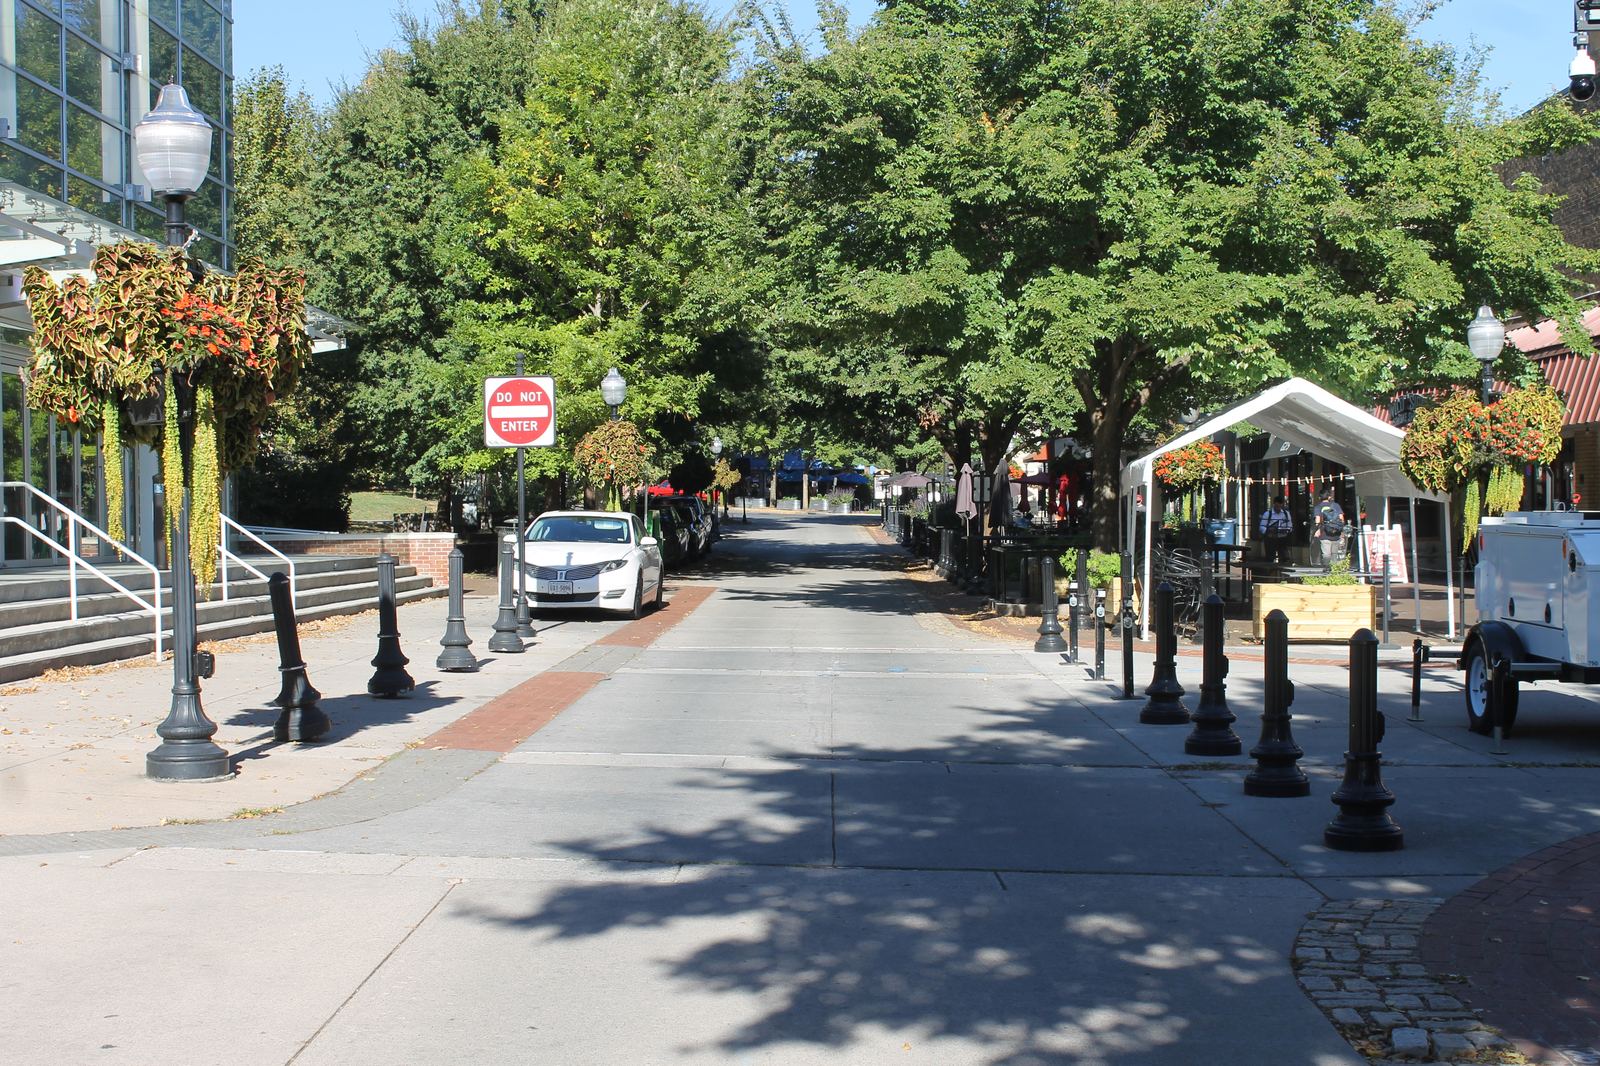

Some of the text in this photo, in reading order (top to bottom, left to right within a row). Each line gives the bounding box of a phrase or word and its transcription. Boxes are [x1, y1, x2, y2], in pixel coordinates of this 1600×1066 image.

[496, 391, 542, 403] DO NOT
[501, 421, 538, 432] ENTER
